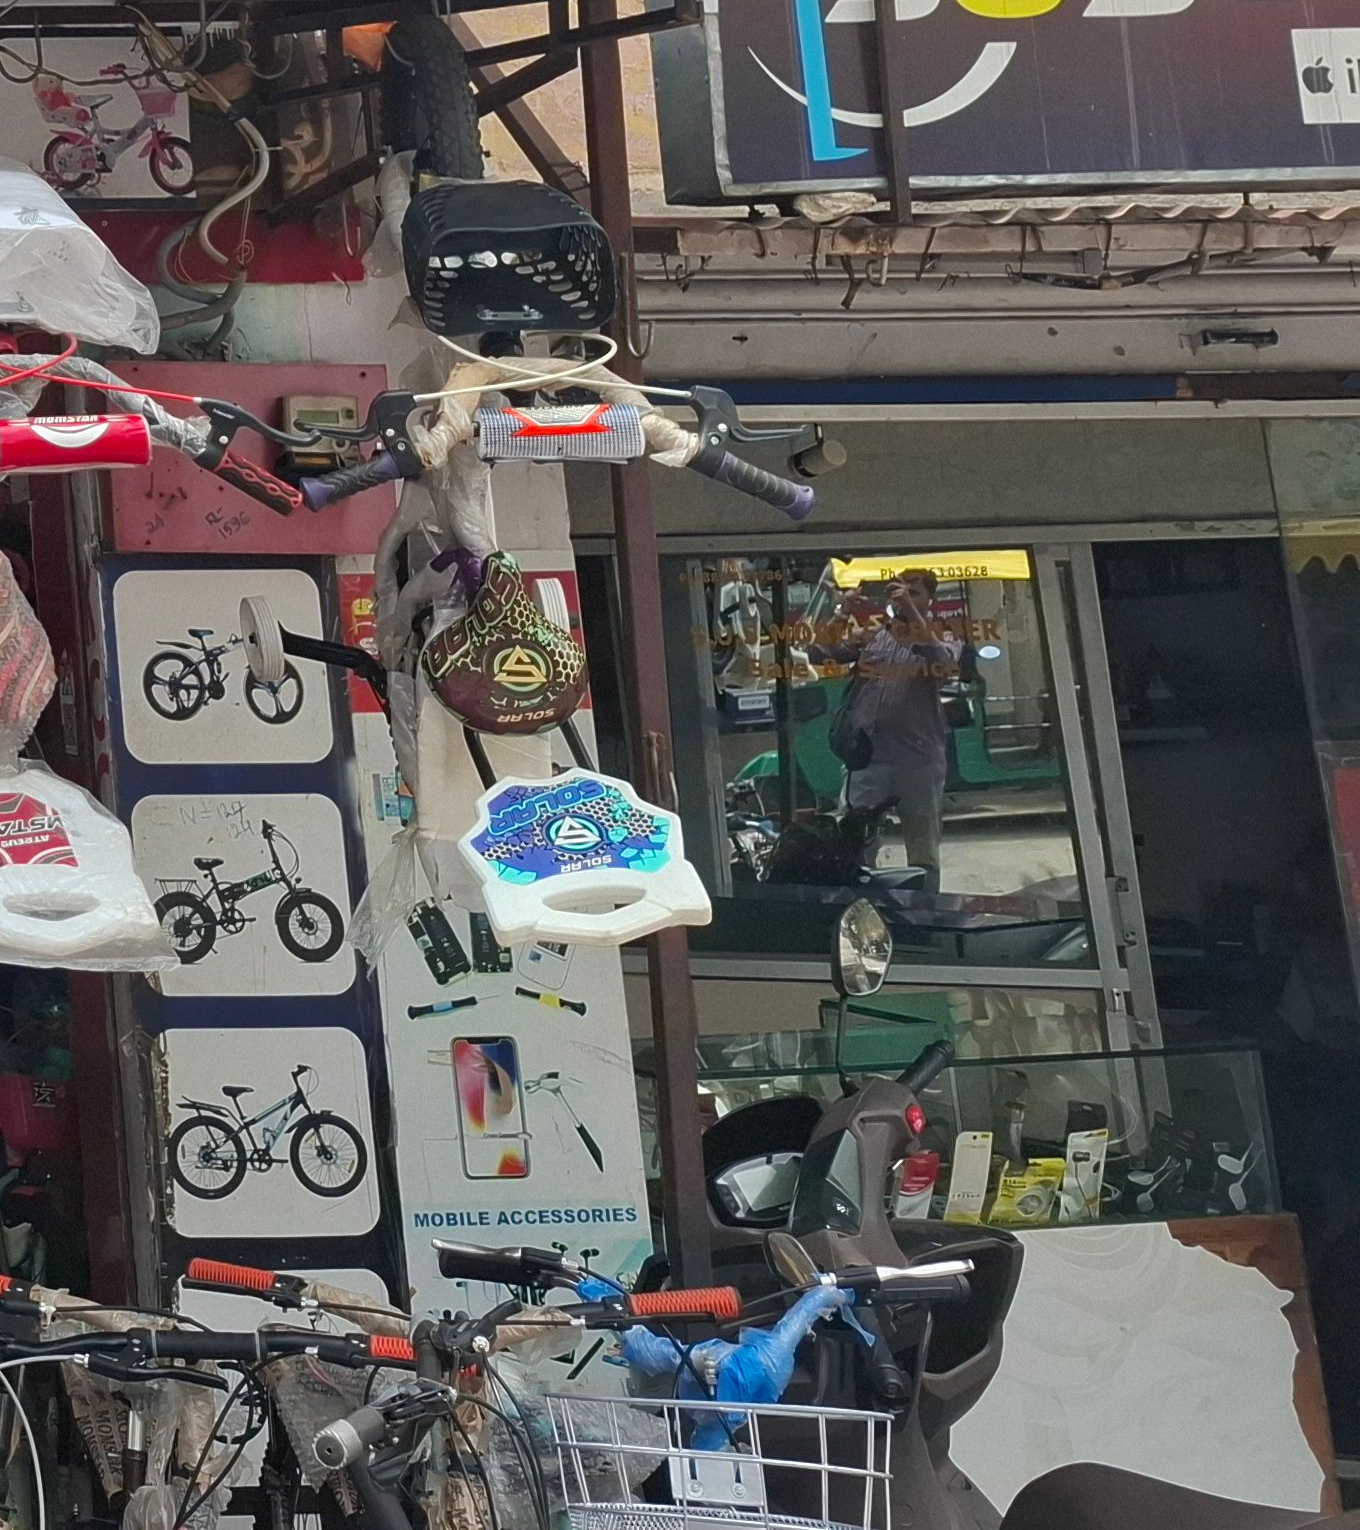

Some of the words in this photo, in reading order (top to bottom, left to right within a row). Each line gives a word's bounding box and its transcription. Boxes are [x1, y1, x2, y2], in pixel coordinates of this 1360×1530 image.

[496, 707, 557, 724] SOLAR
[487, 777, 607, 837] SOLAR
[560, 854, 613, 874] SOLAR
[413, 1209, 490, 1228] MOBILE
[495, 1205, 639, 1228] ACCESSORIES
